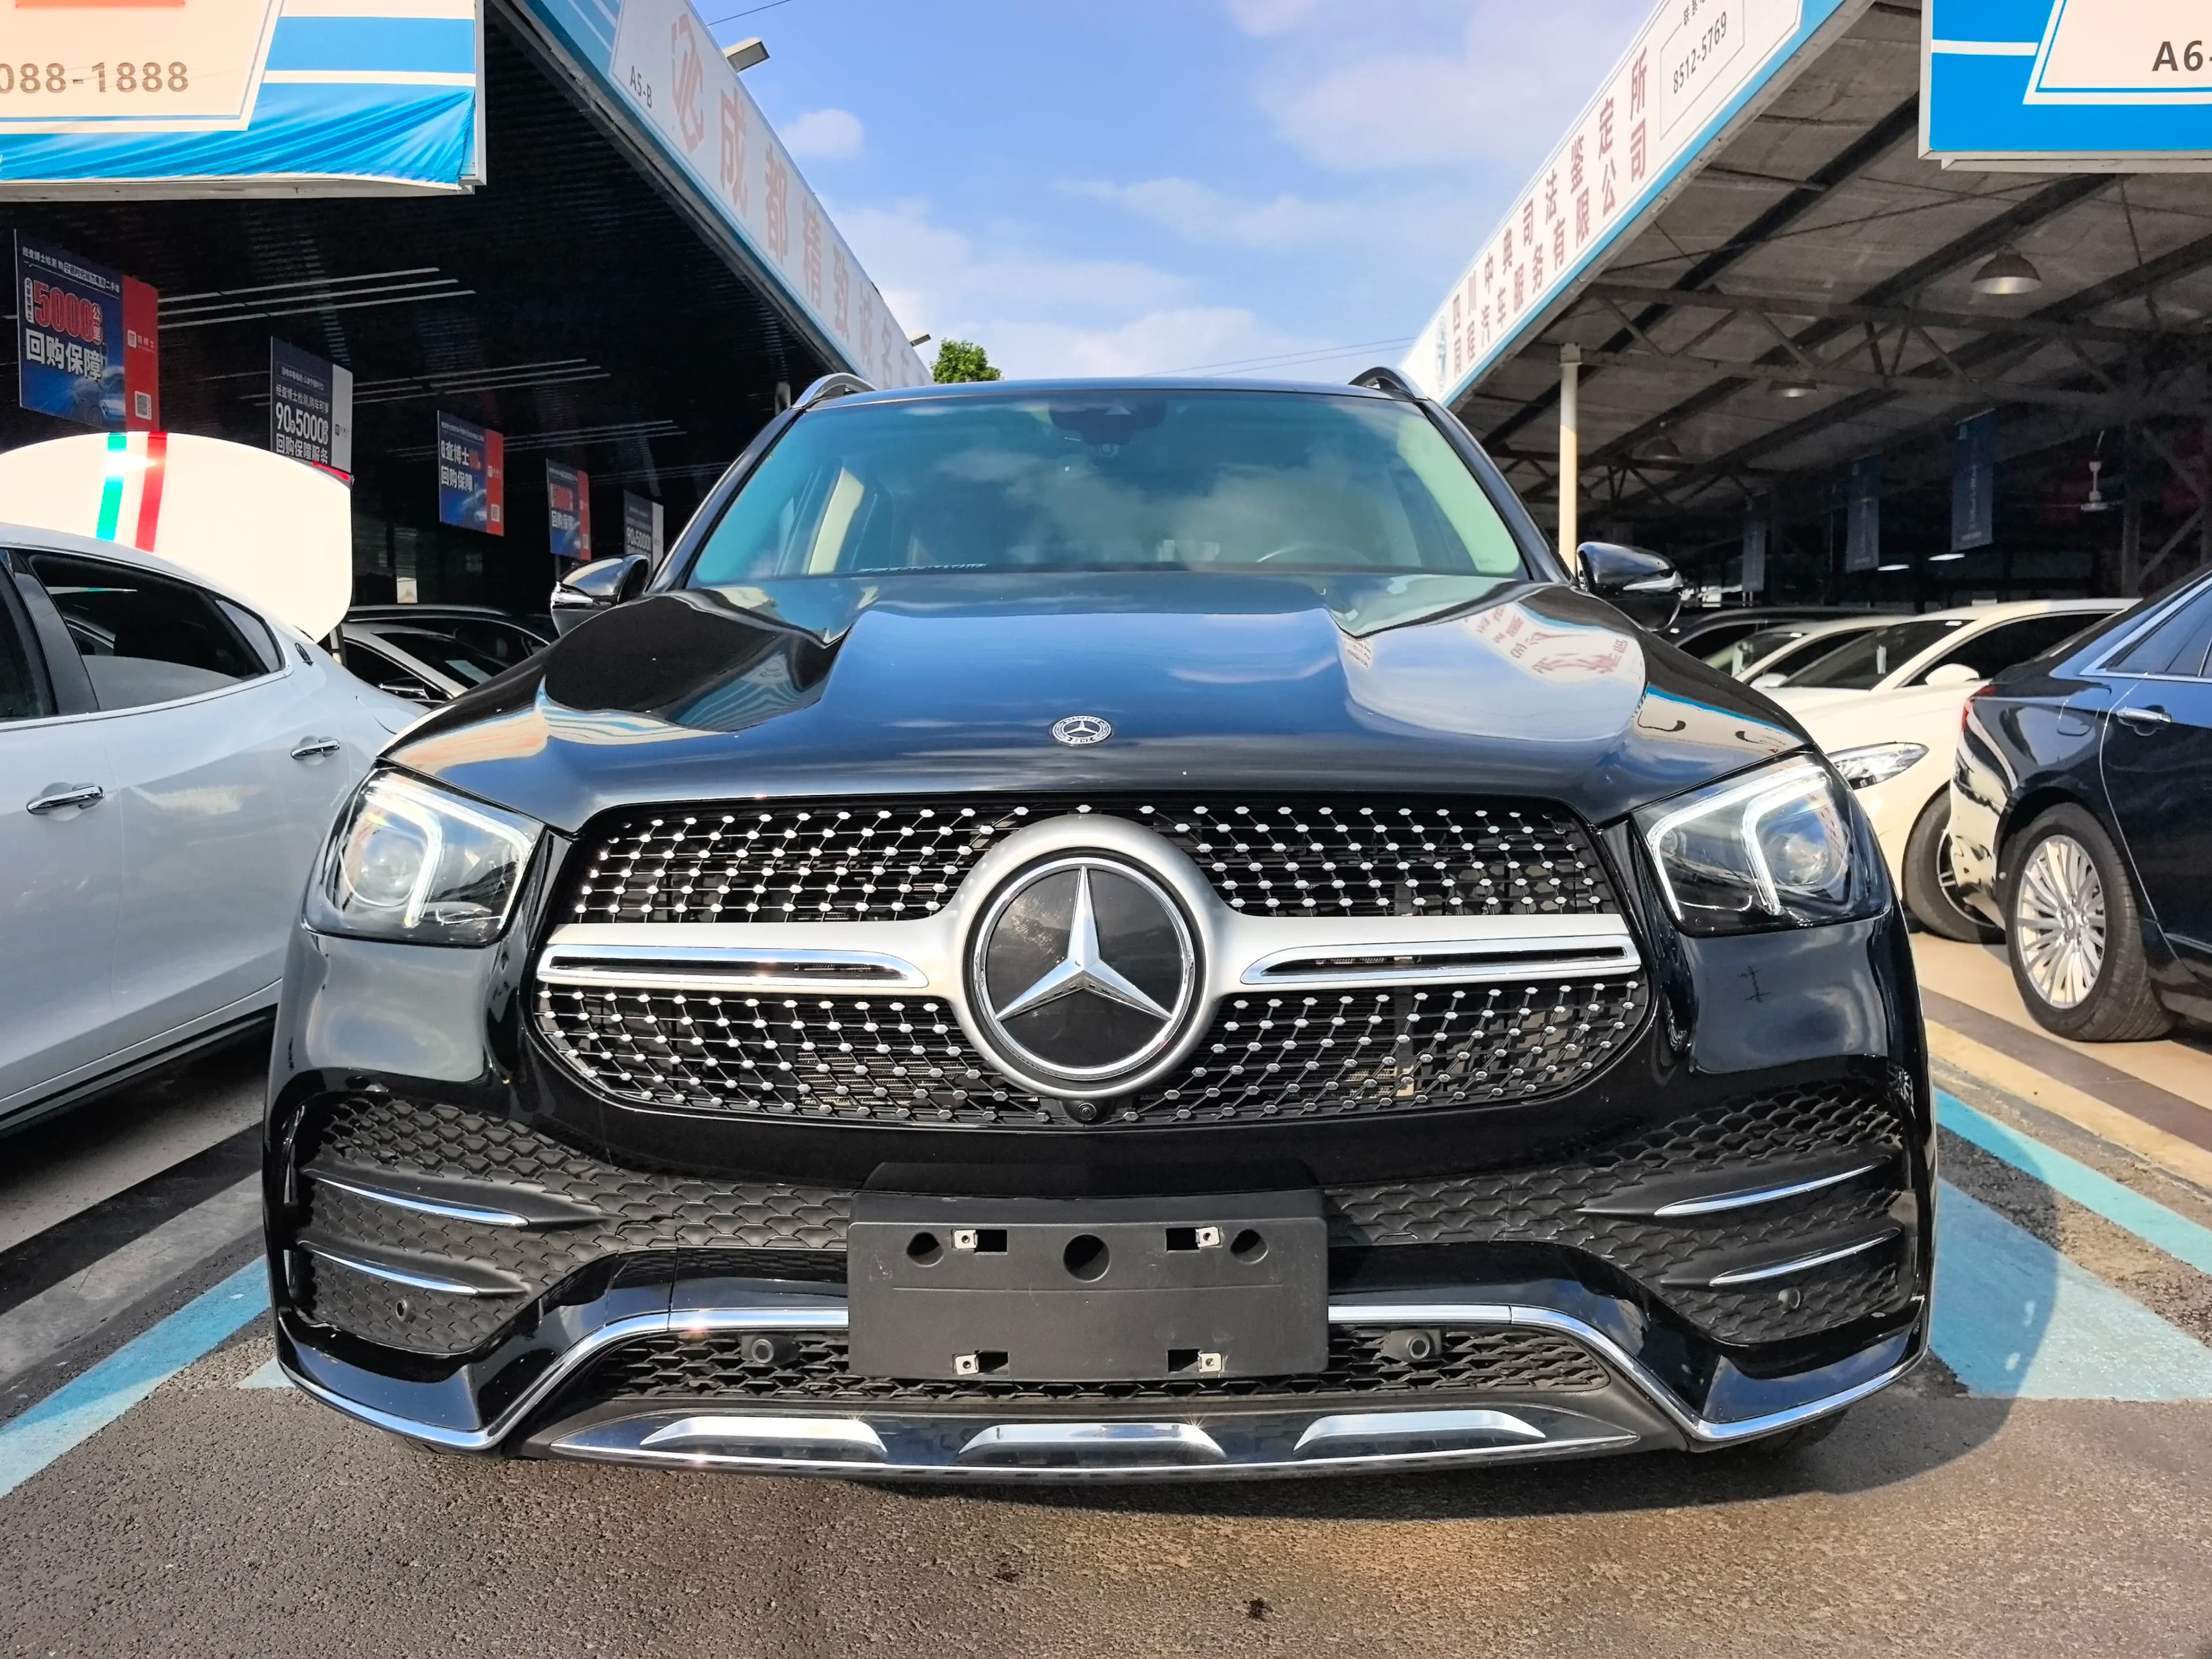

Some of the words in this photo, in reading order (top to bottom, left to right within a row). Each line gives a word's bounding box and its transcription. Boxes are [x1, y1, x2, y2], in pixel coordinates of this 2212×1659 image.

[1673, 11, 1727, 94] 8512-5769
[2152, 40, 2212, 71] A6
[0, 62, 189, 93] 088-1888
[630, 66, 653, 108] A5-B
[1452, 46, 1649, 334] 四川中典司法鉴定所
[26, 329, 102, 382] 回购保障
